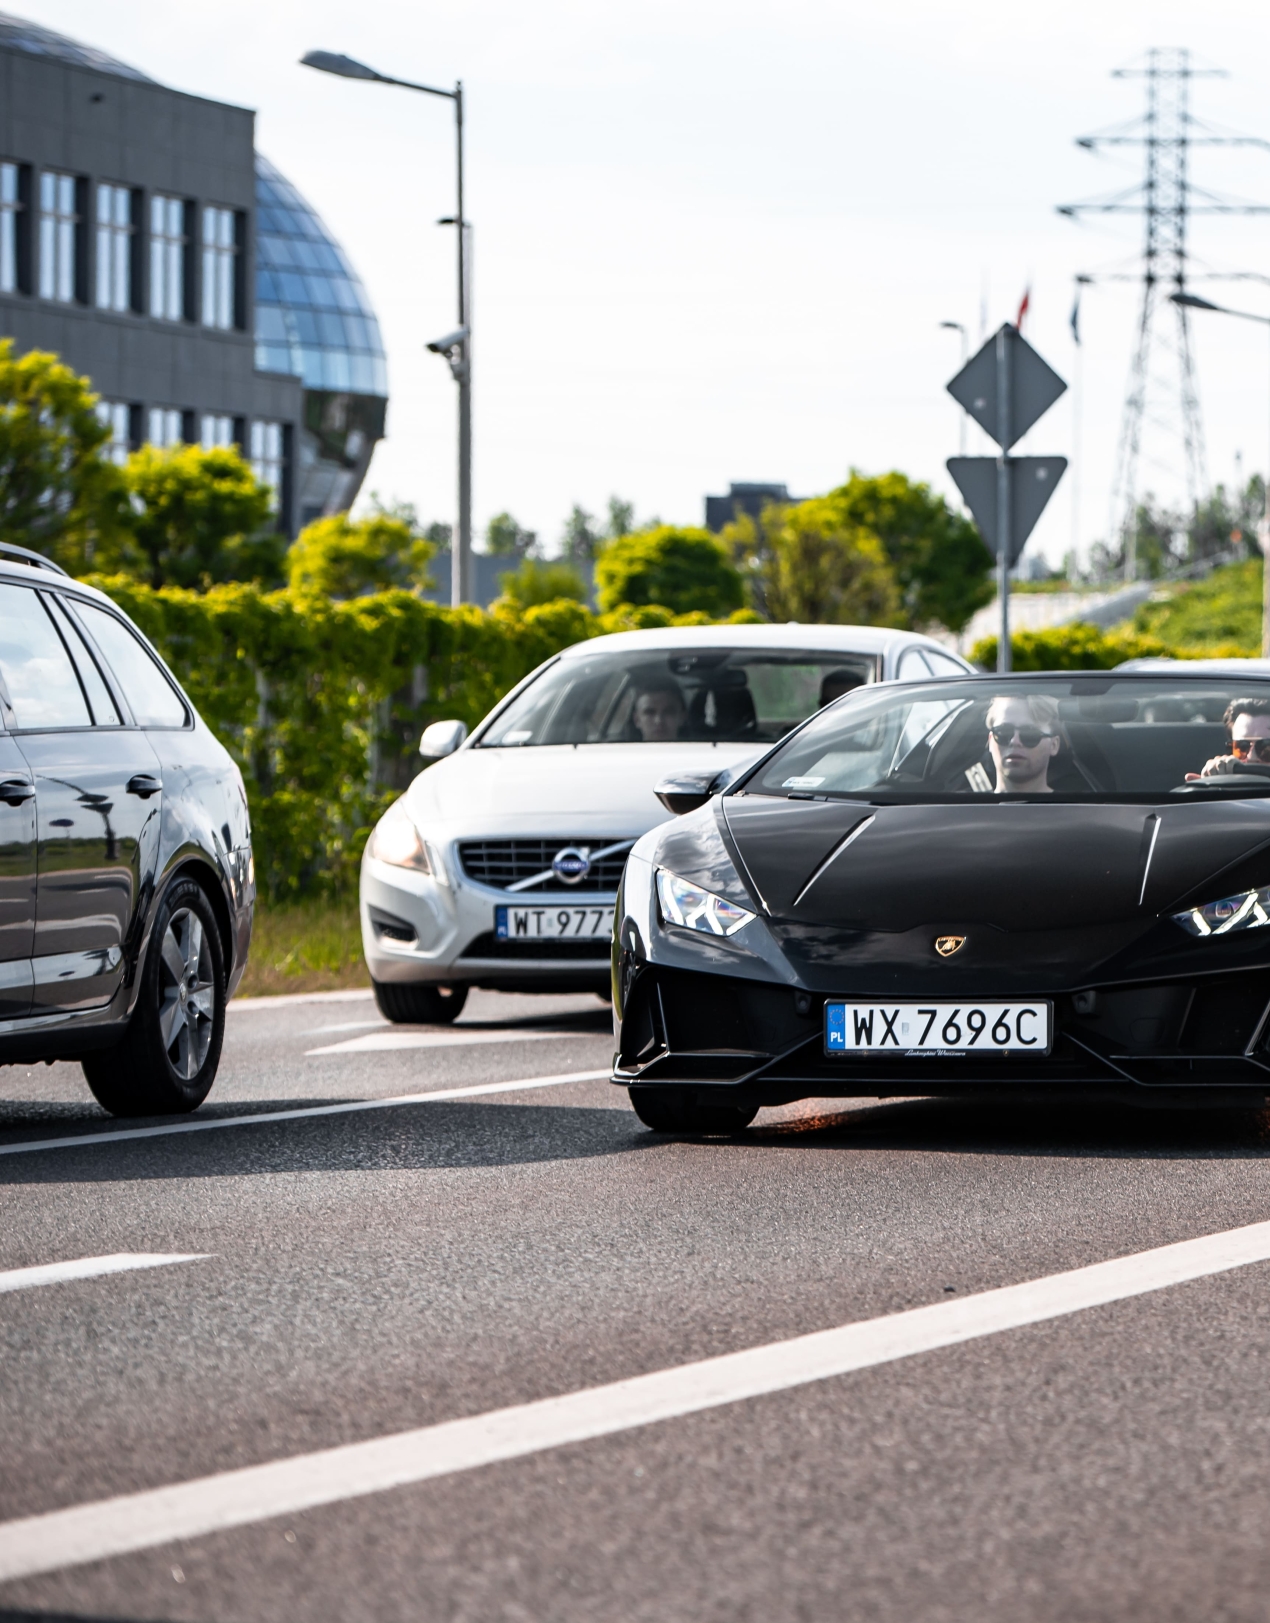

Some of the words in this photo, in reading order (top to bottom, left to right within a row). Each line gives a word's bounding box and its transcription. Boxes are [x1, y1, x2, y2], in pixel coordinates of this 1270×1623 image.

[514, 911, 545, 935] WT
[830, 1031, 844, 1043] PL
[853, 1008, 900, 1046] WX
[917, 1008, 1038, 1046] 7696C
